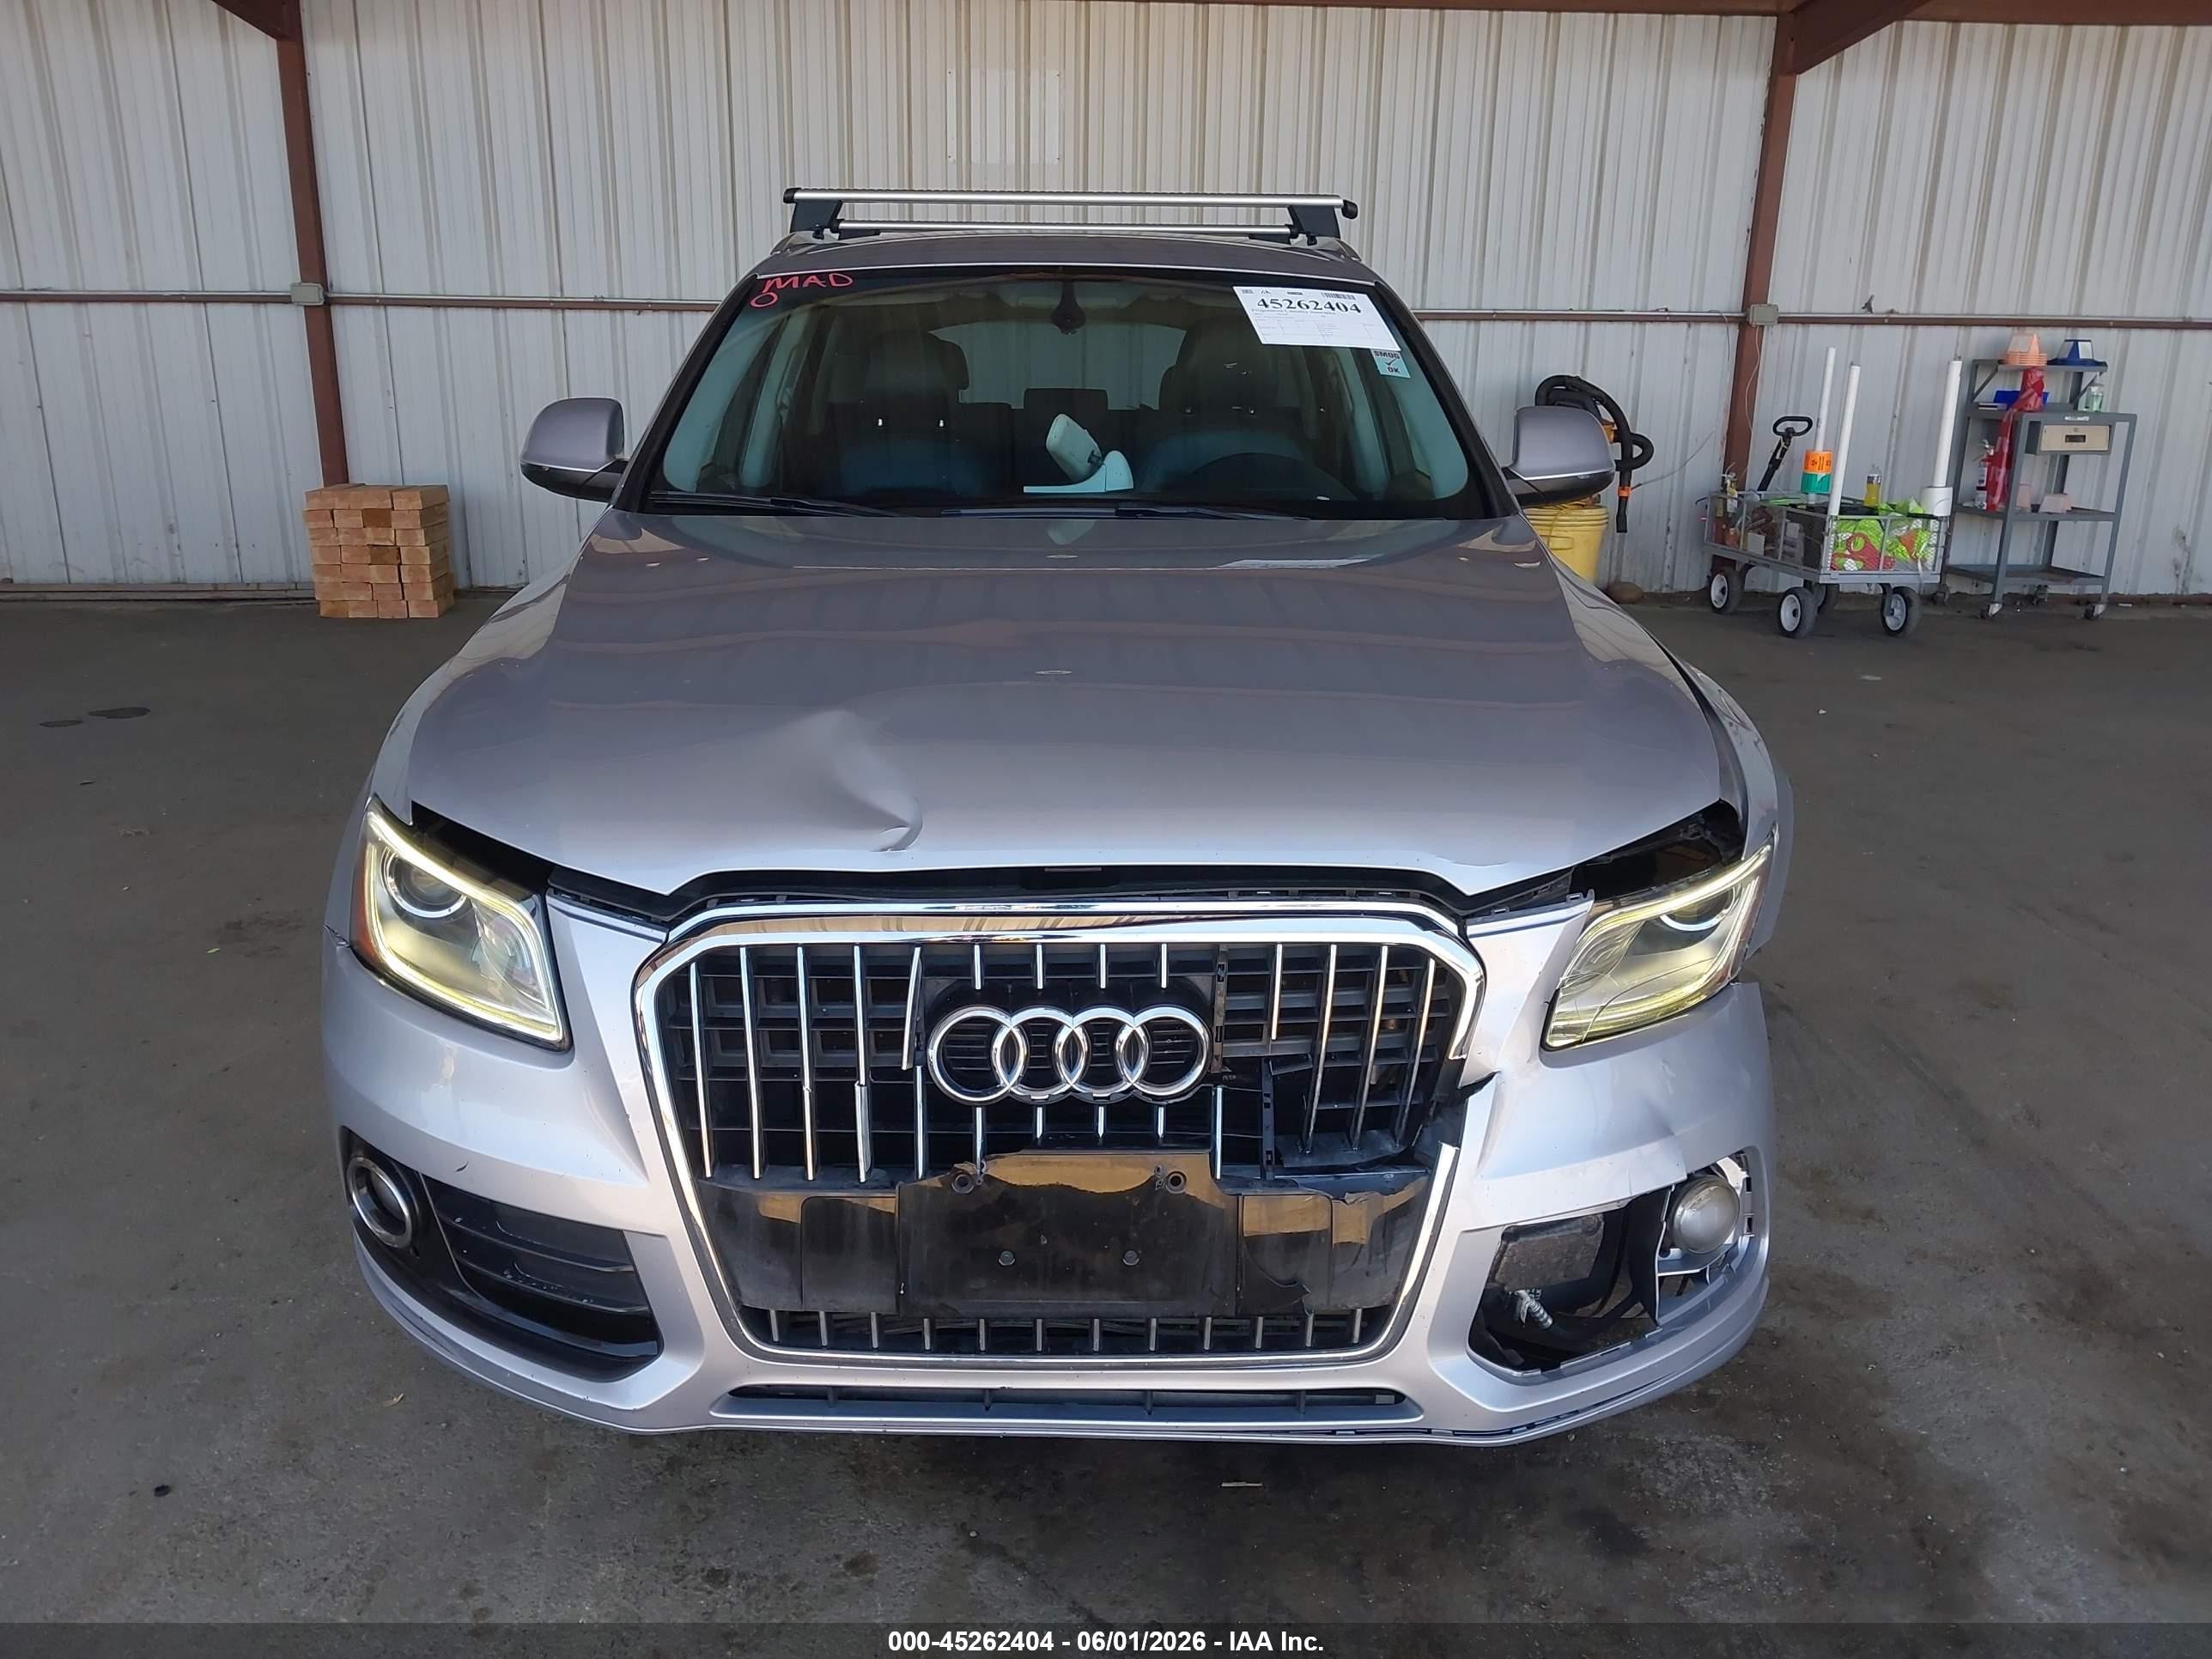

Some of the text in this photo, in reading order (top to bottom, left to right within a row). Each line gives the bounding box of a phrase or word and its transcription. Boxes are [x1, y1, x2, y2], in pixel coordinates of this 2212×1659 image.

[762, 273, 854, 293] MAD
[1257, 298, 1361, 313] 45262404
[1374, 350, 1401, 359] SMOG
